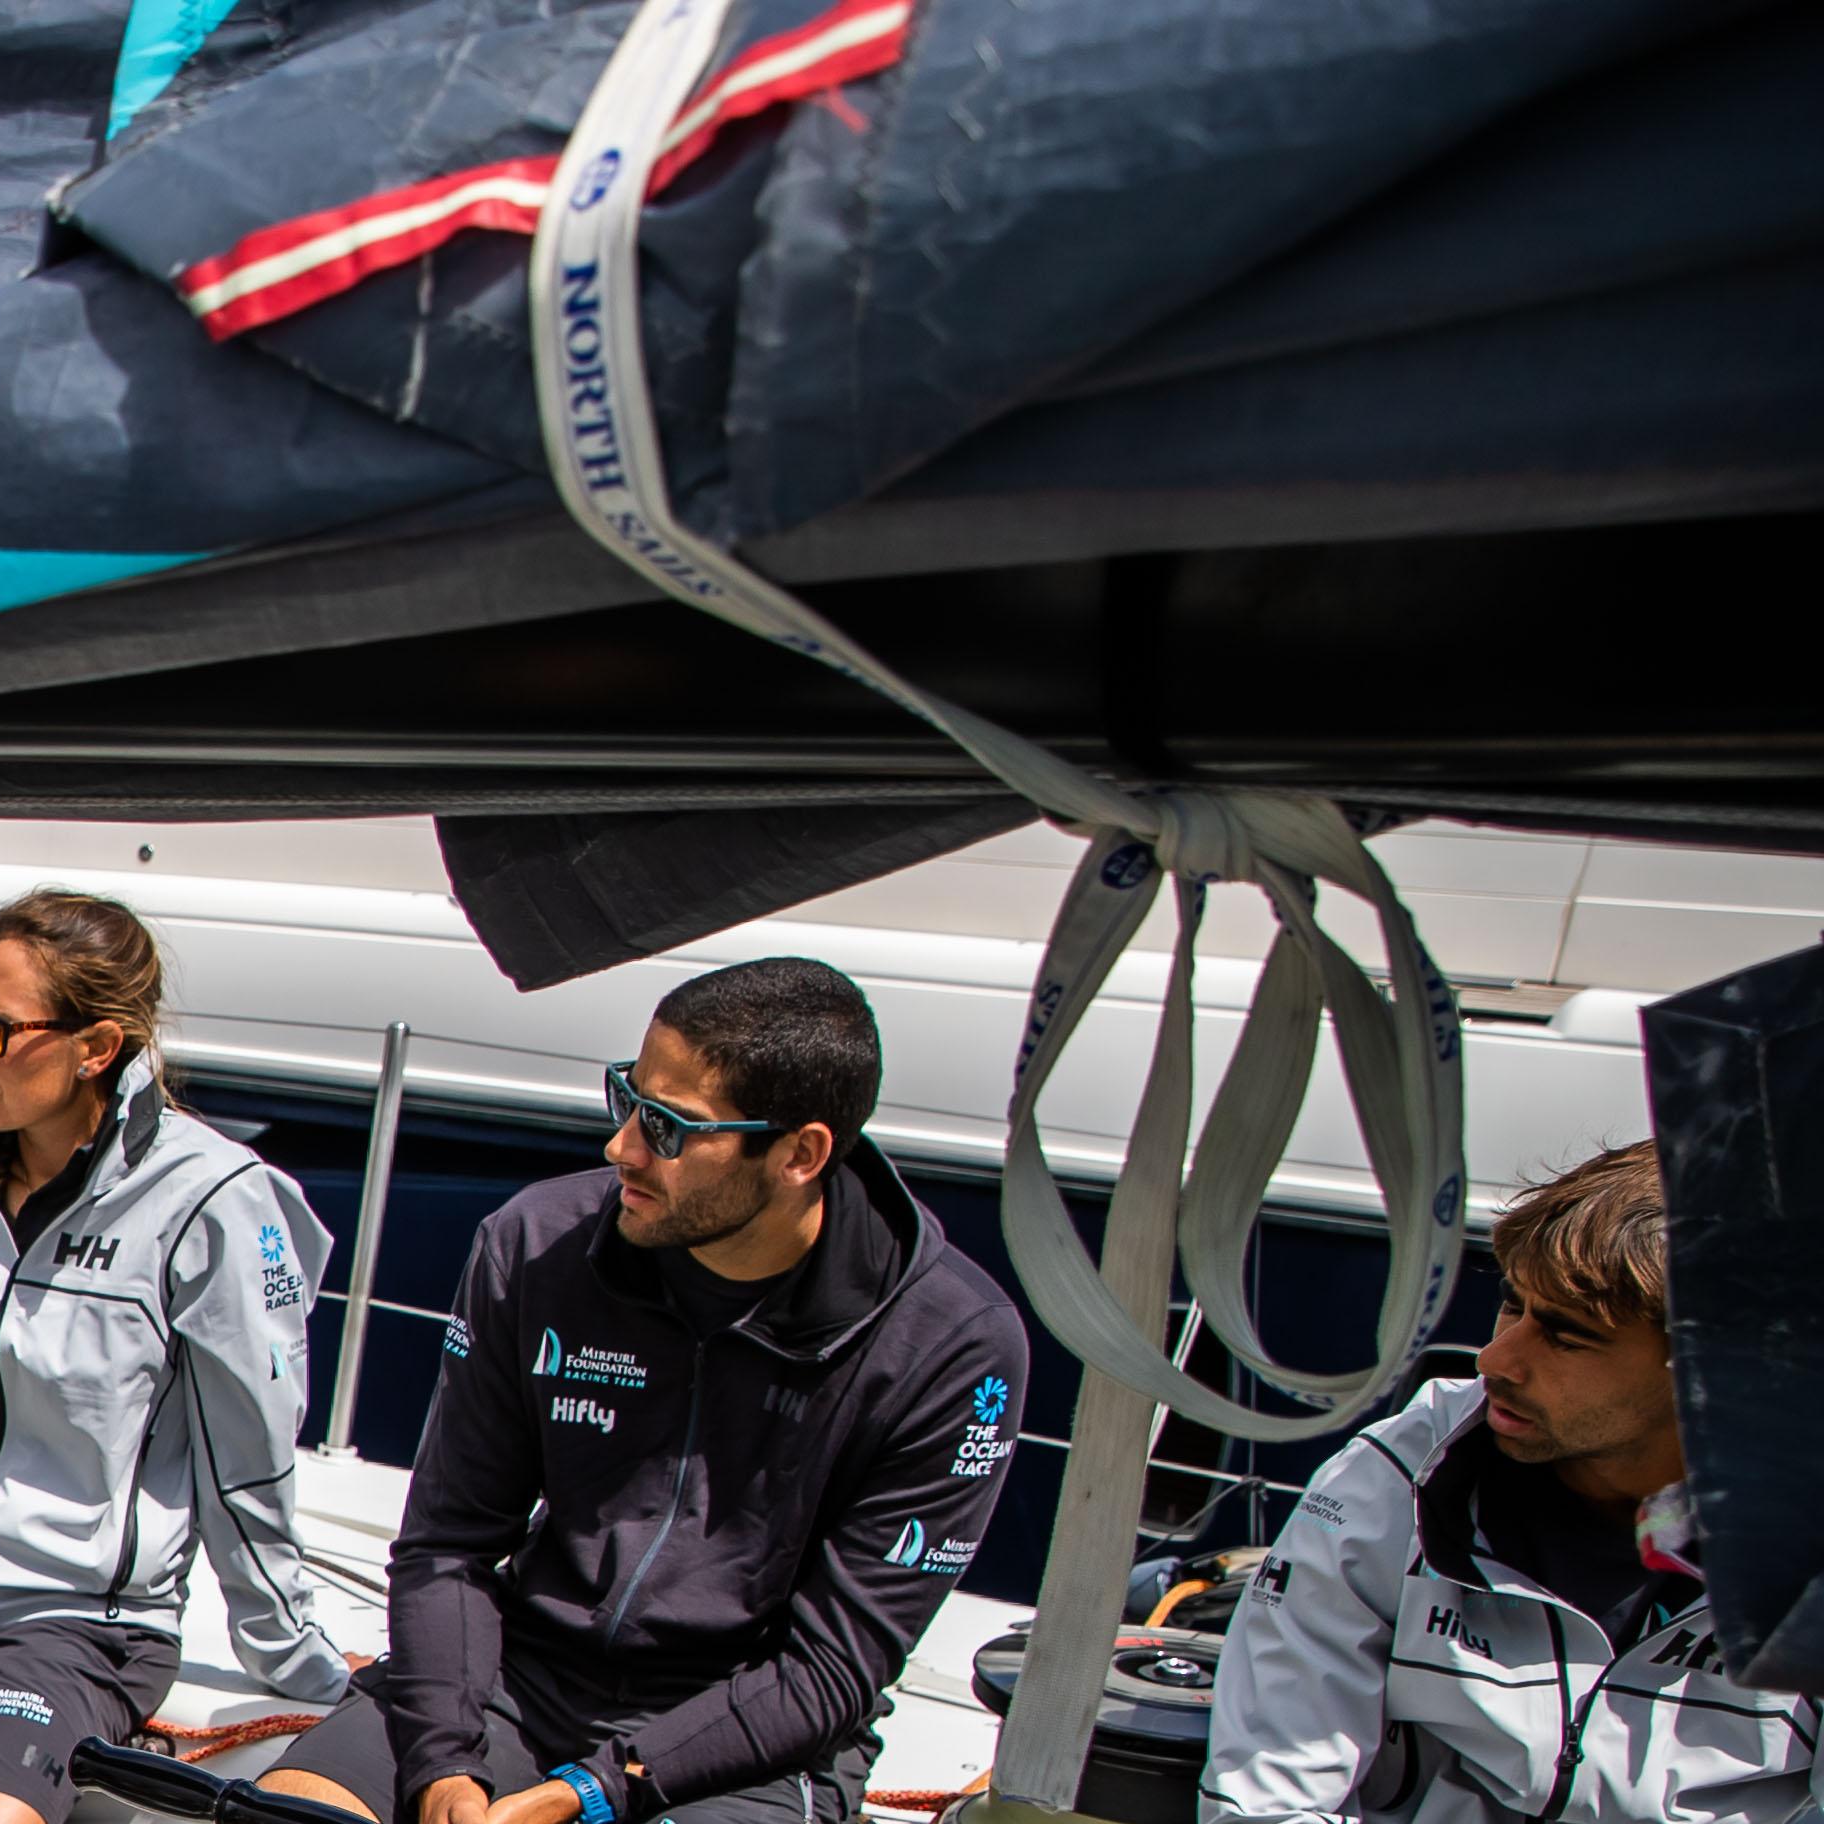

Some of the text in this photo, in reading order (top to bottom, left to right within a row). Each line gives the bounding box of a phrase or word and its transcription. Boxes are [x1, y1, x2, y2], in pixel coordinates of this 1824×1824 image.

[561, 260, 723, 596] NORTH SAILS
[53, 1231, 121, 1271] HH
[262, 1263, 288, 1281] THE
[264, 1274, 305, 1297] OCEA
[265, 1291, 301, 1312] RACE
[580, 1345, 636, 1364] MIRPURI
[566, 1354, 648, 1378] FOUNDATION
[564, 1371, 647, 1389] RACING TEAM
[551, 1396, 616, 1433] Hifly
[966, 1425, 1000, 1441] THE
[958, 1440, 1014, 1460] OCEAN
[950, 1459, 996, 1477] RACE
[21, 1709, 51, 1725] TEAM
